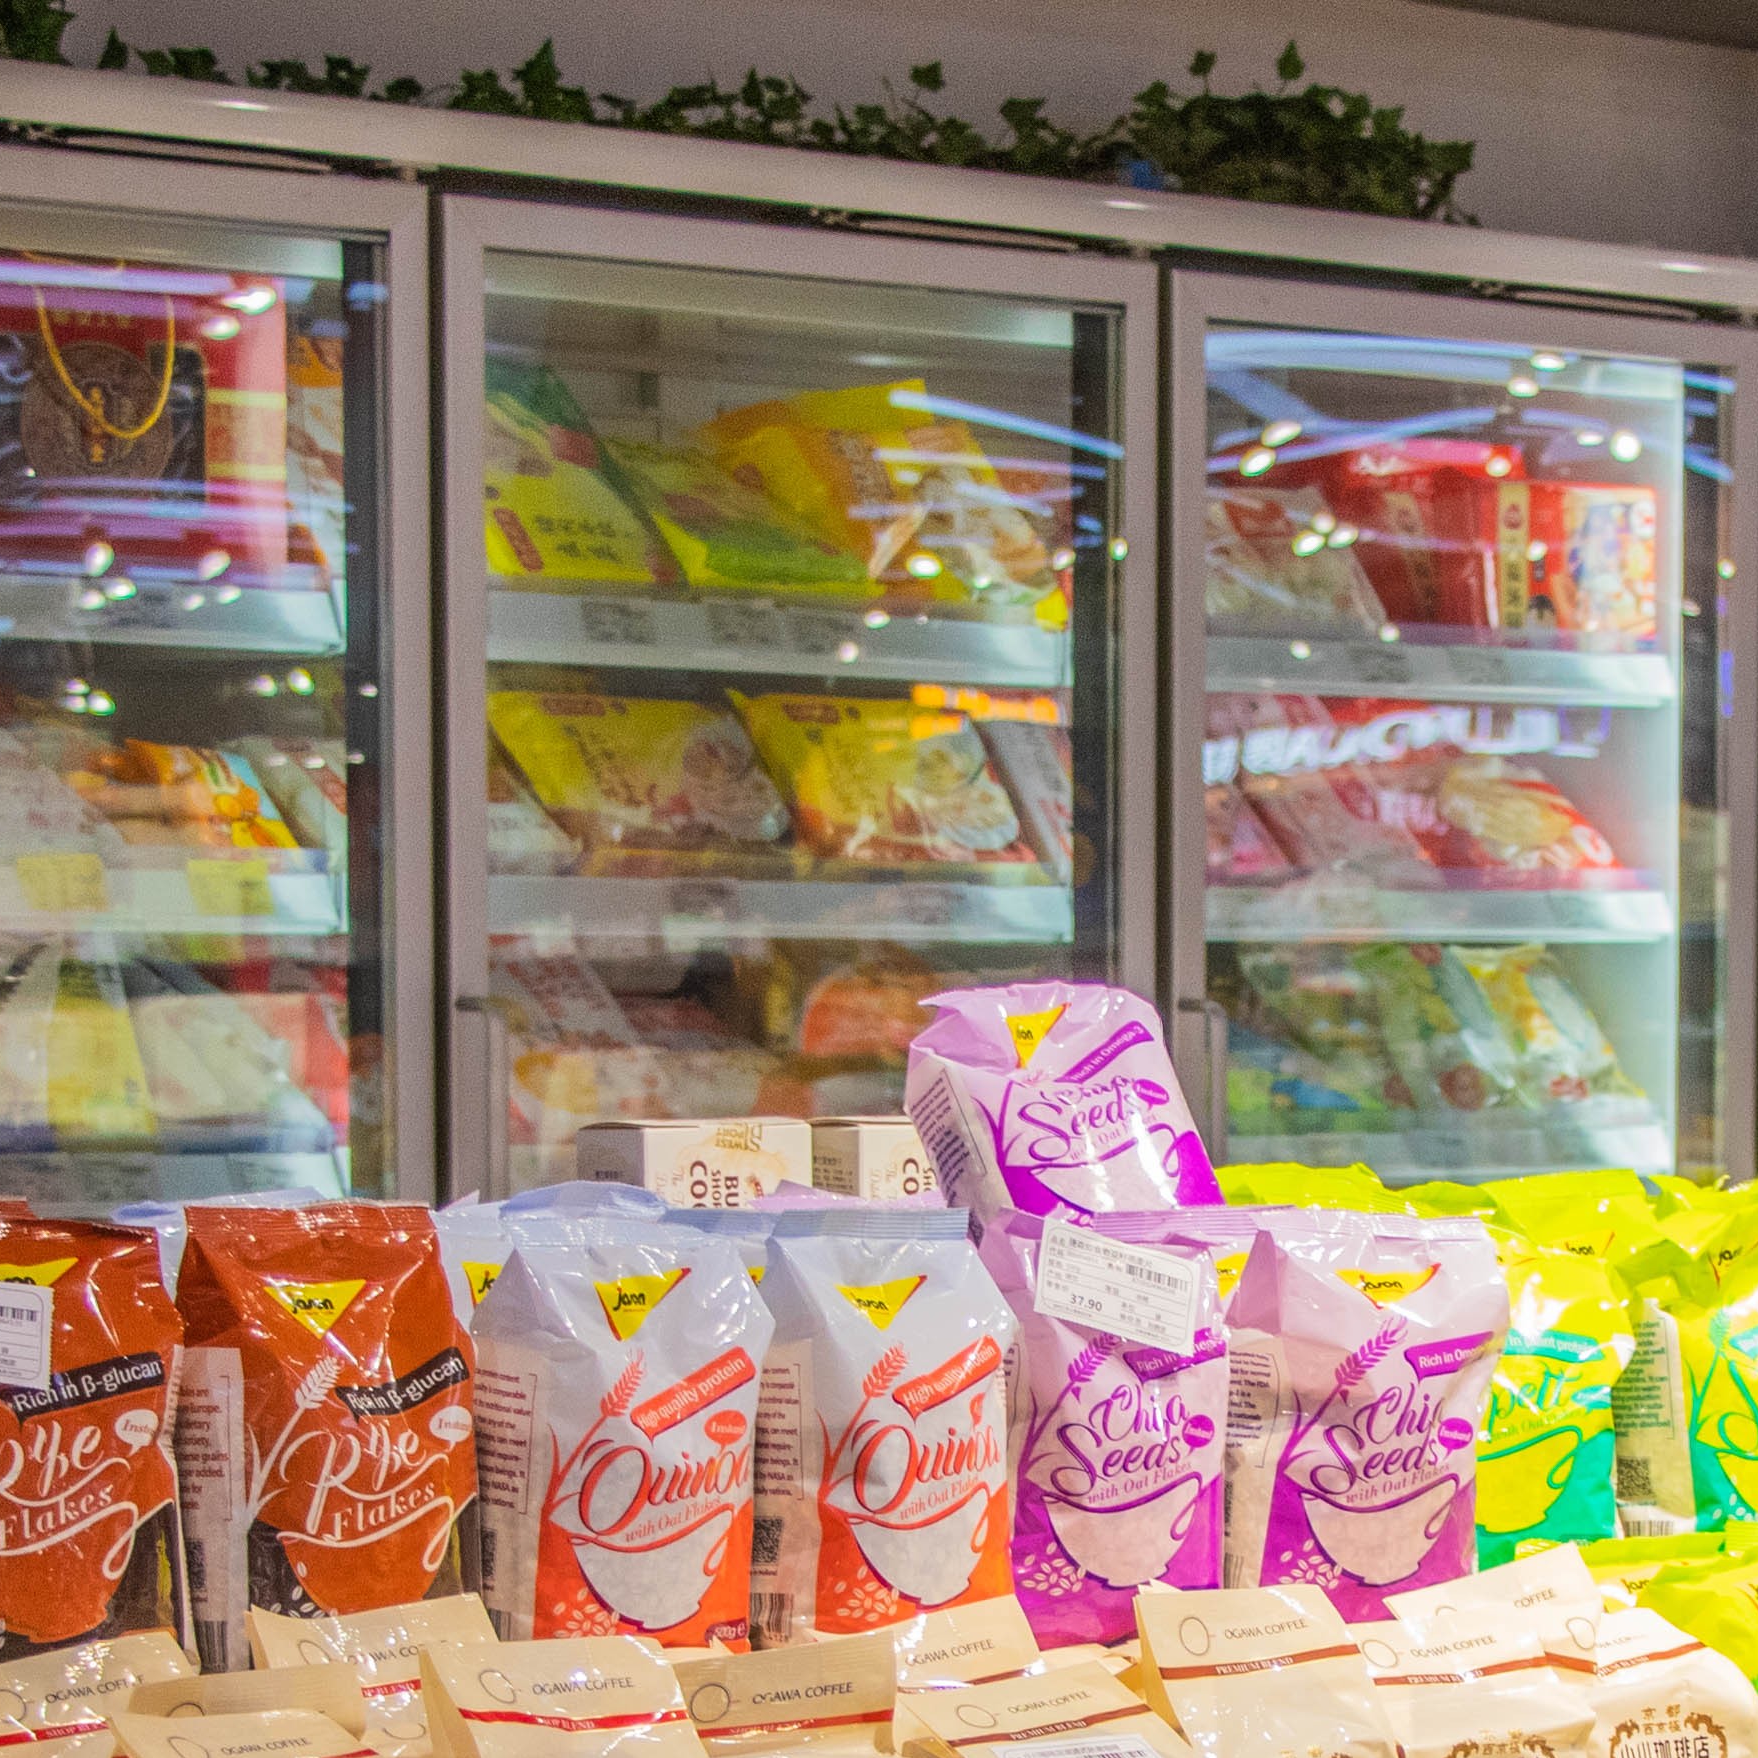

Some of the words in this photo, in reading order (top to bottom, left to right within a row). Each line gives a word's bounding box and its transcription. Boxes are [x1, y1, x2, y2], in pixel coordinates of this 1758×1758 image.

[1017, 1086, 1139, 1142] Seeds
[1070, 1294, 1102, 1312] 37.90
[12, 1384, 56, 1414] Rich
[59, 1379, 77, 1403] in
[852, 1416, 1001, 1514] Quinoa
[1050, 1421, 1185, 1496] Seeds
[1309, 1422, 1445, 1496] Seeds
[577, 1430, 752, 1538] Quinoa
[332, 1480, 437, 1542] Flakes
[1224, 1624, 1262, 1641] OGAWA
[1264, 1617, 1309, 1636] COFFEE
[1454, 1634, 1496, 1653] COFFEE
[531, 1679, 582, 1696] OGAWA
[583, 1674, 635, 1693] COFFEE
[751, 1687, 801, 1705] OGAWA
[804, 1680, 854, 1700] COFFEE
[219, 1739, 263, 1758] OGAWA
[264, 1735, 313, 1753] COFFEE
